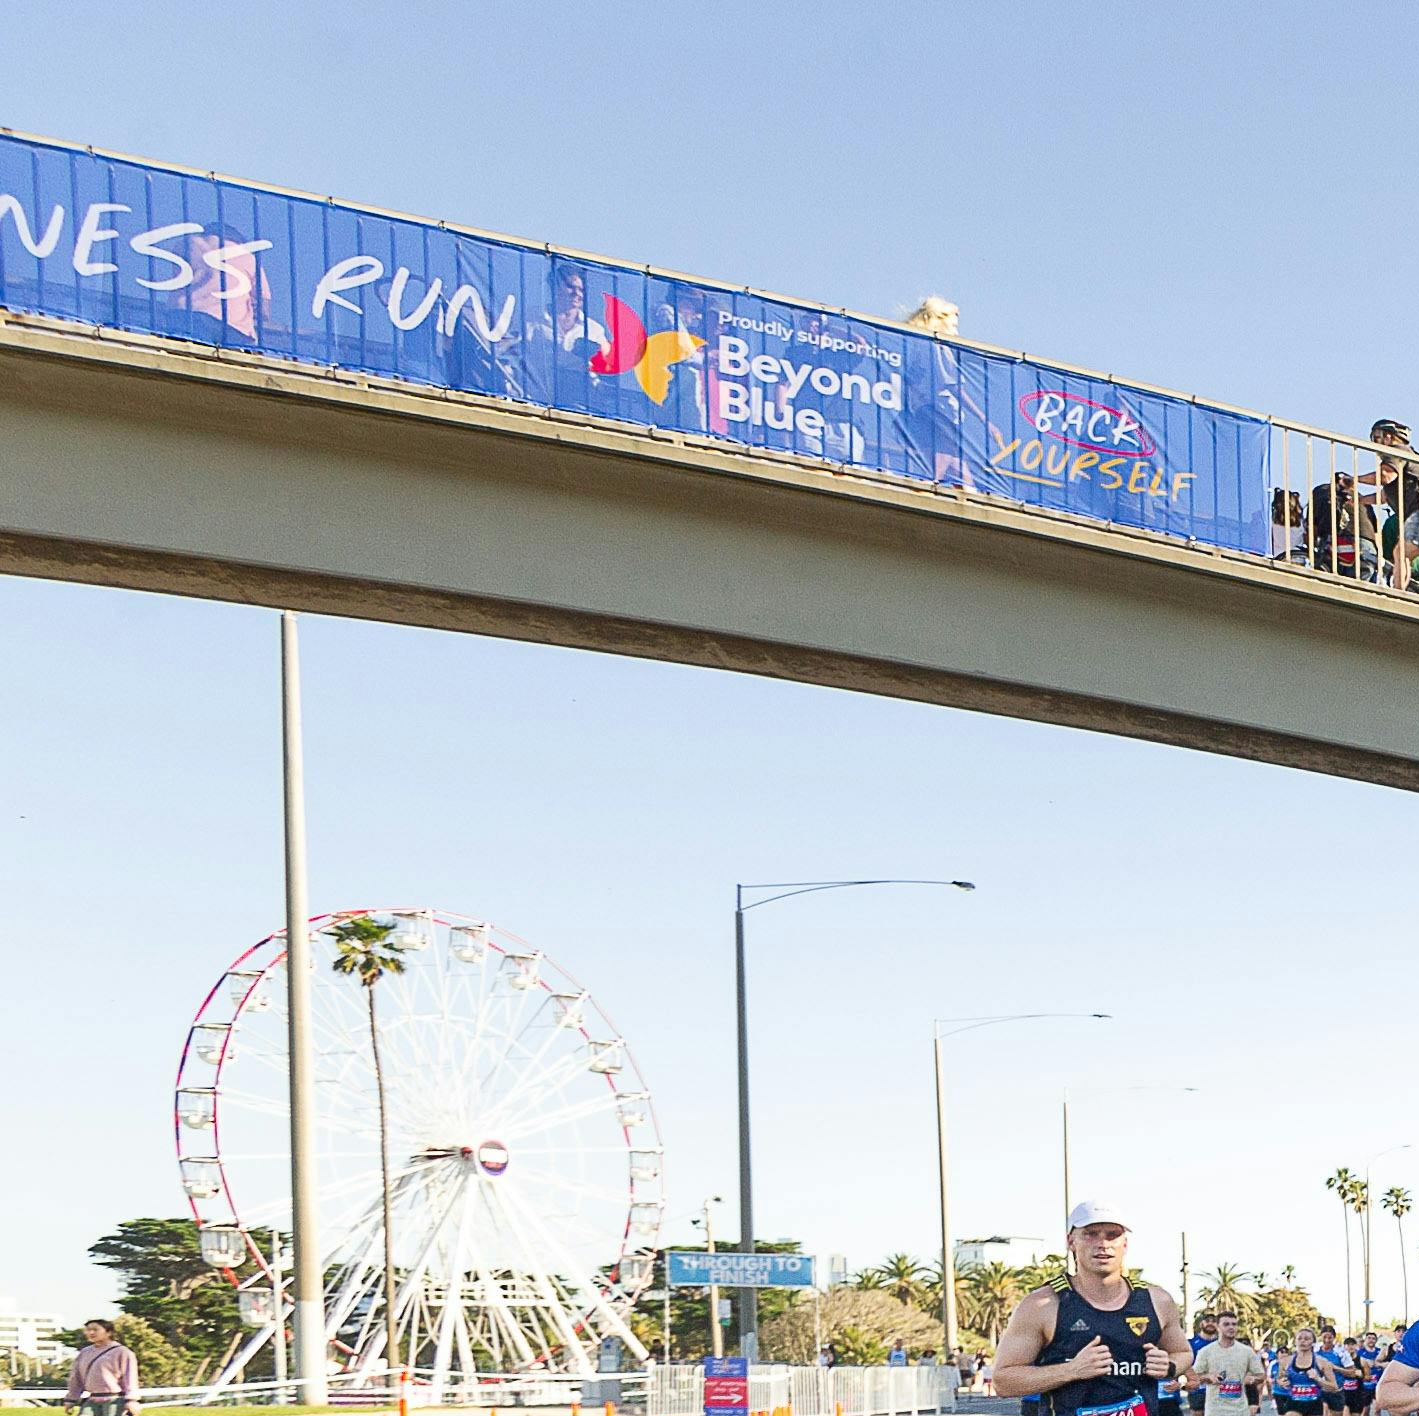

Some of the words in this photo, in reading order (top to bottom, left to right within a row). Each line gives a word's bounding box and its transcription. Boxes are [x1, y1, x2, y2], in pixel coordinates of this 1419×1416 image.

[311, 255, 516, 343] RUN
[718, 311, 794, 342] Proudly
[797, 330, 902, 367] supporting
[718, 335, 902, 411] Beyond
[719, 380, 826, 439] Blue
[1035, 393, 1140, 447] BACK
[988, 424, 1198, 502] YOURSELF
[680, 1256, 771, 1272] THROUGH
[774, 1257, 801, 1272] TO
[709, 1270, 769, 1284] FINISH
